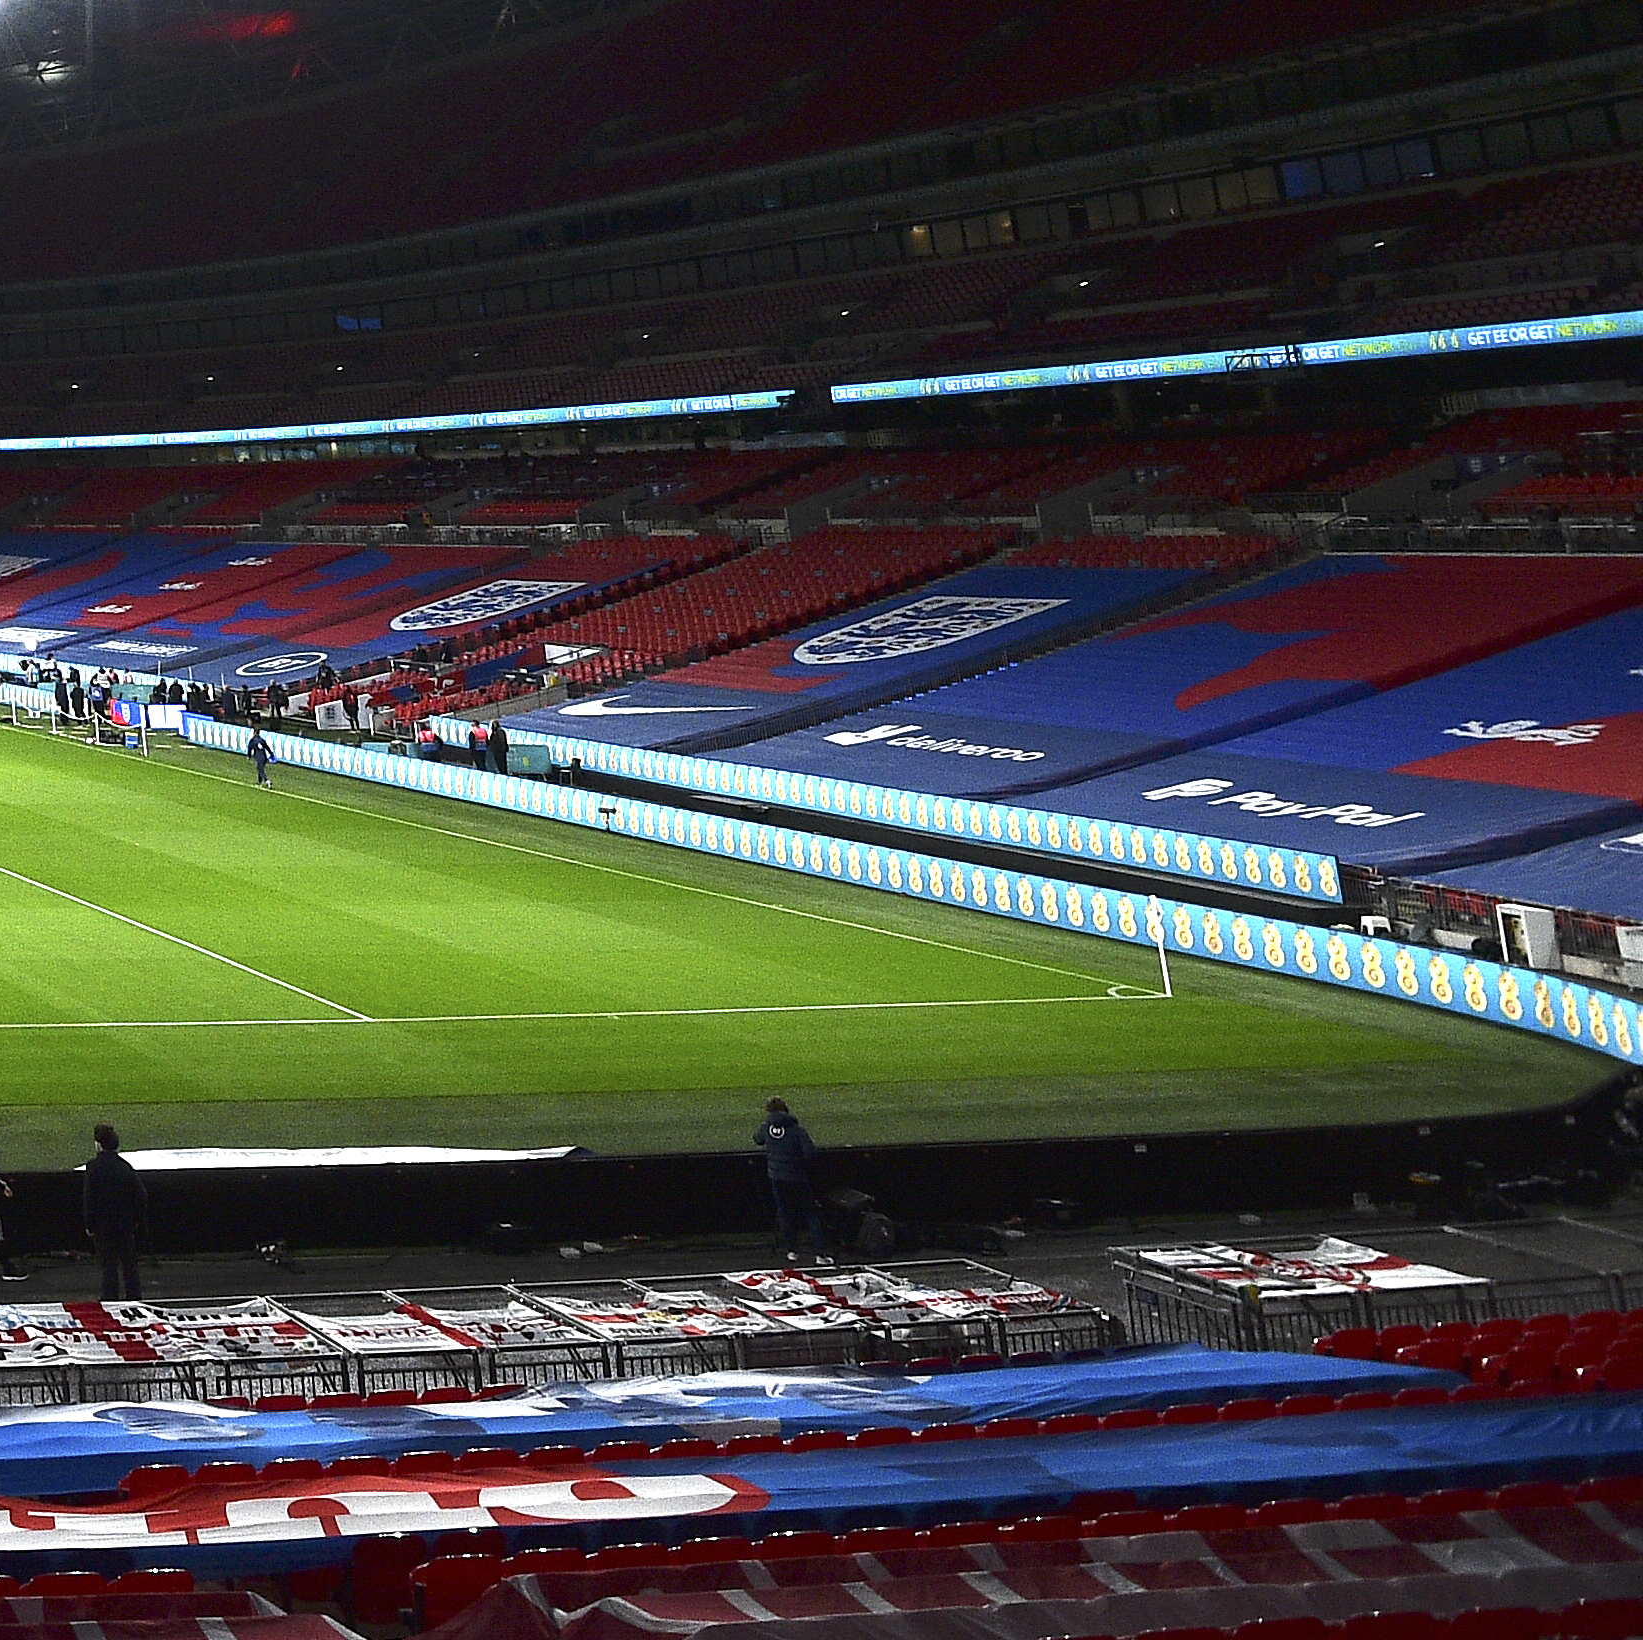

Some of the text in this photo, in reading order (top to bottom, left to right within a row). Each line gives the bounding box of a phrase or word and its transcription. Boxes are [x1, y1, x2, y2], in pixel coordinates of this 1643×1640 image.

[1468, 331, 1492, 345] GET
[1493, 329, 1509, 343] EE
[1529, 324, 1553, 340] GET
[892, 731, 1047, 762] deliveroo
[1207, 790, 1425, 828] PayPal
